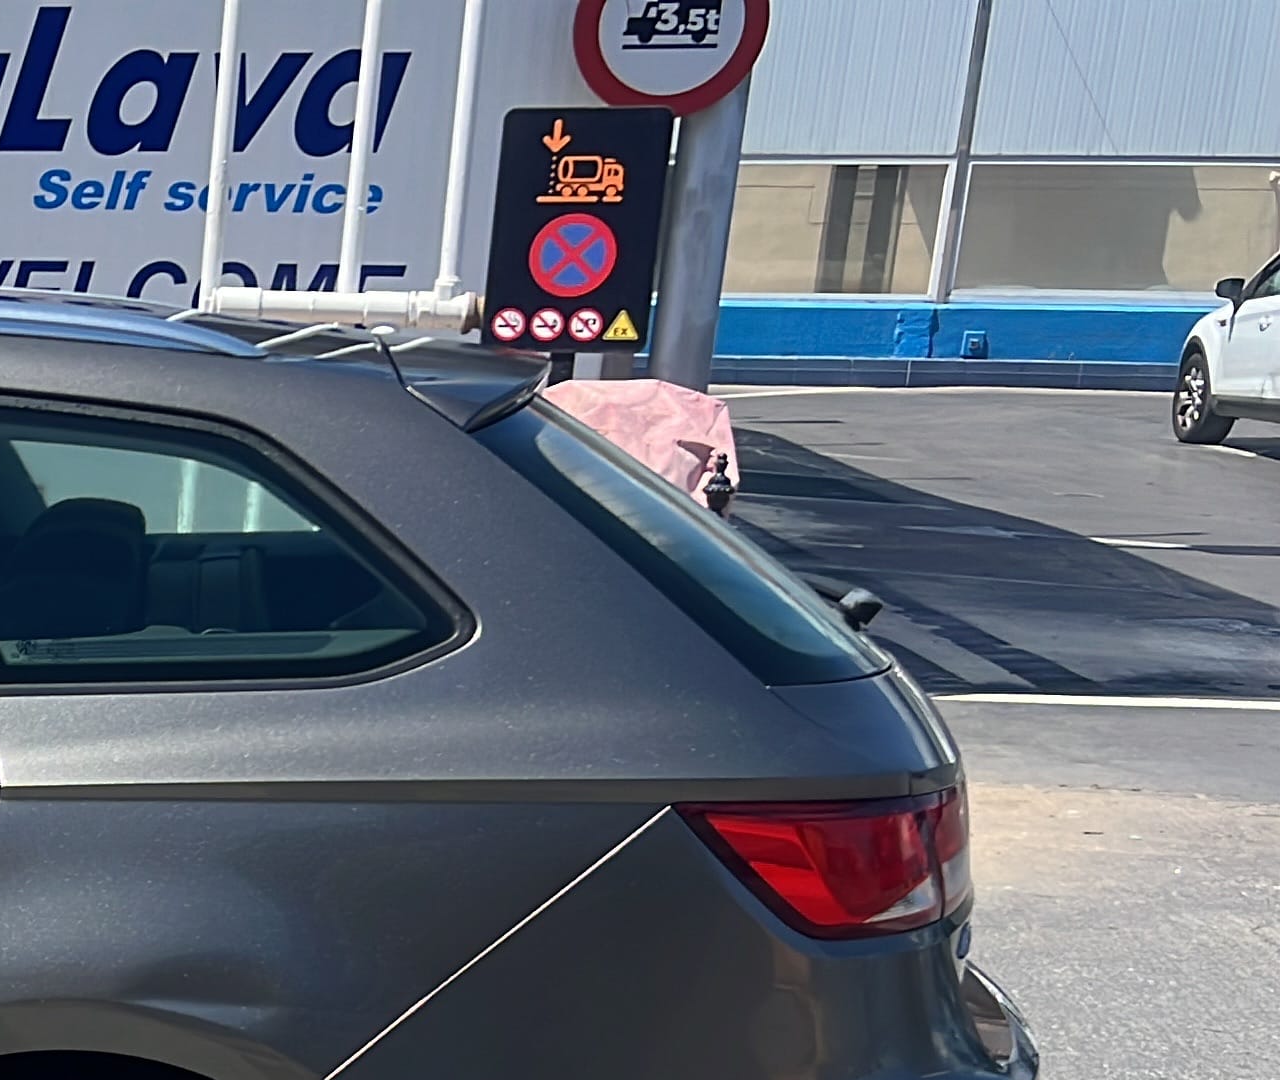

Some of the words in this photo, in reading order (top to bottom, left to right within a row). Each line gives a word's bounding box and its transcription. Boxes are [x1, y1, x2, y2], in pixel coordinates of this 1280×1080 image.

[654, 2, 720, 34] 3,5t
[33, 168, 153, 212] Self
[613, 327, 629, 337] EX
